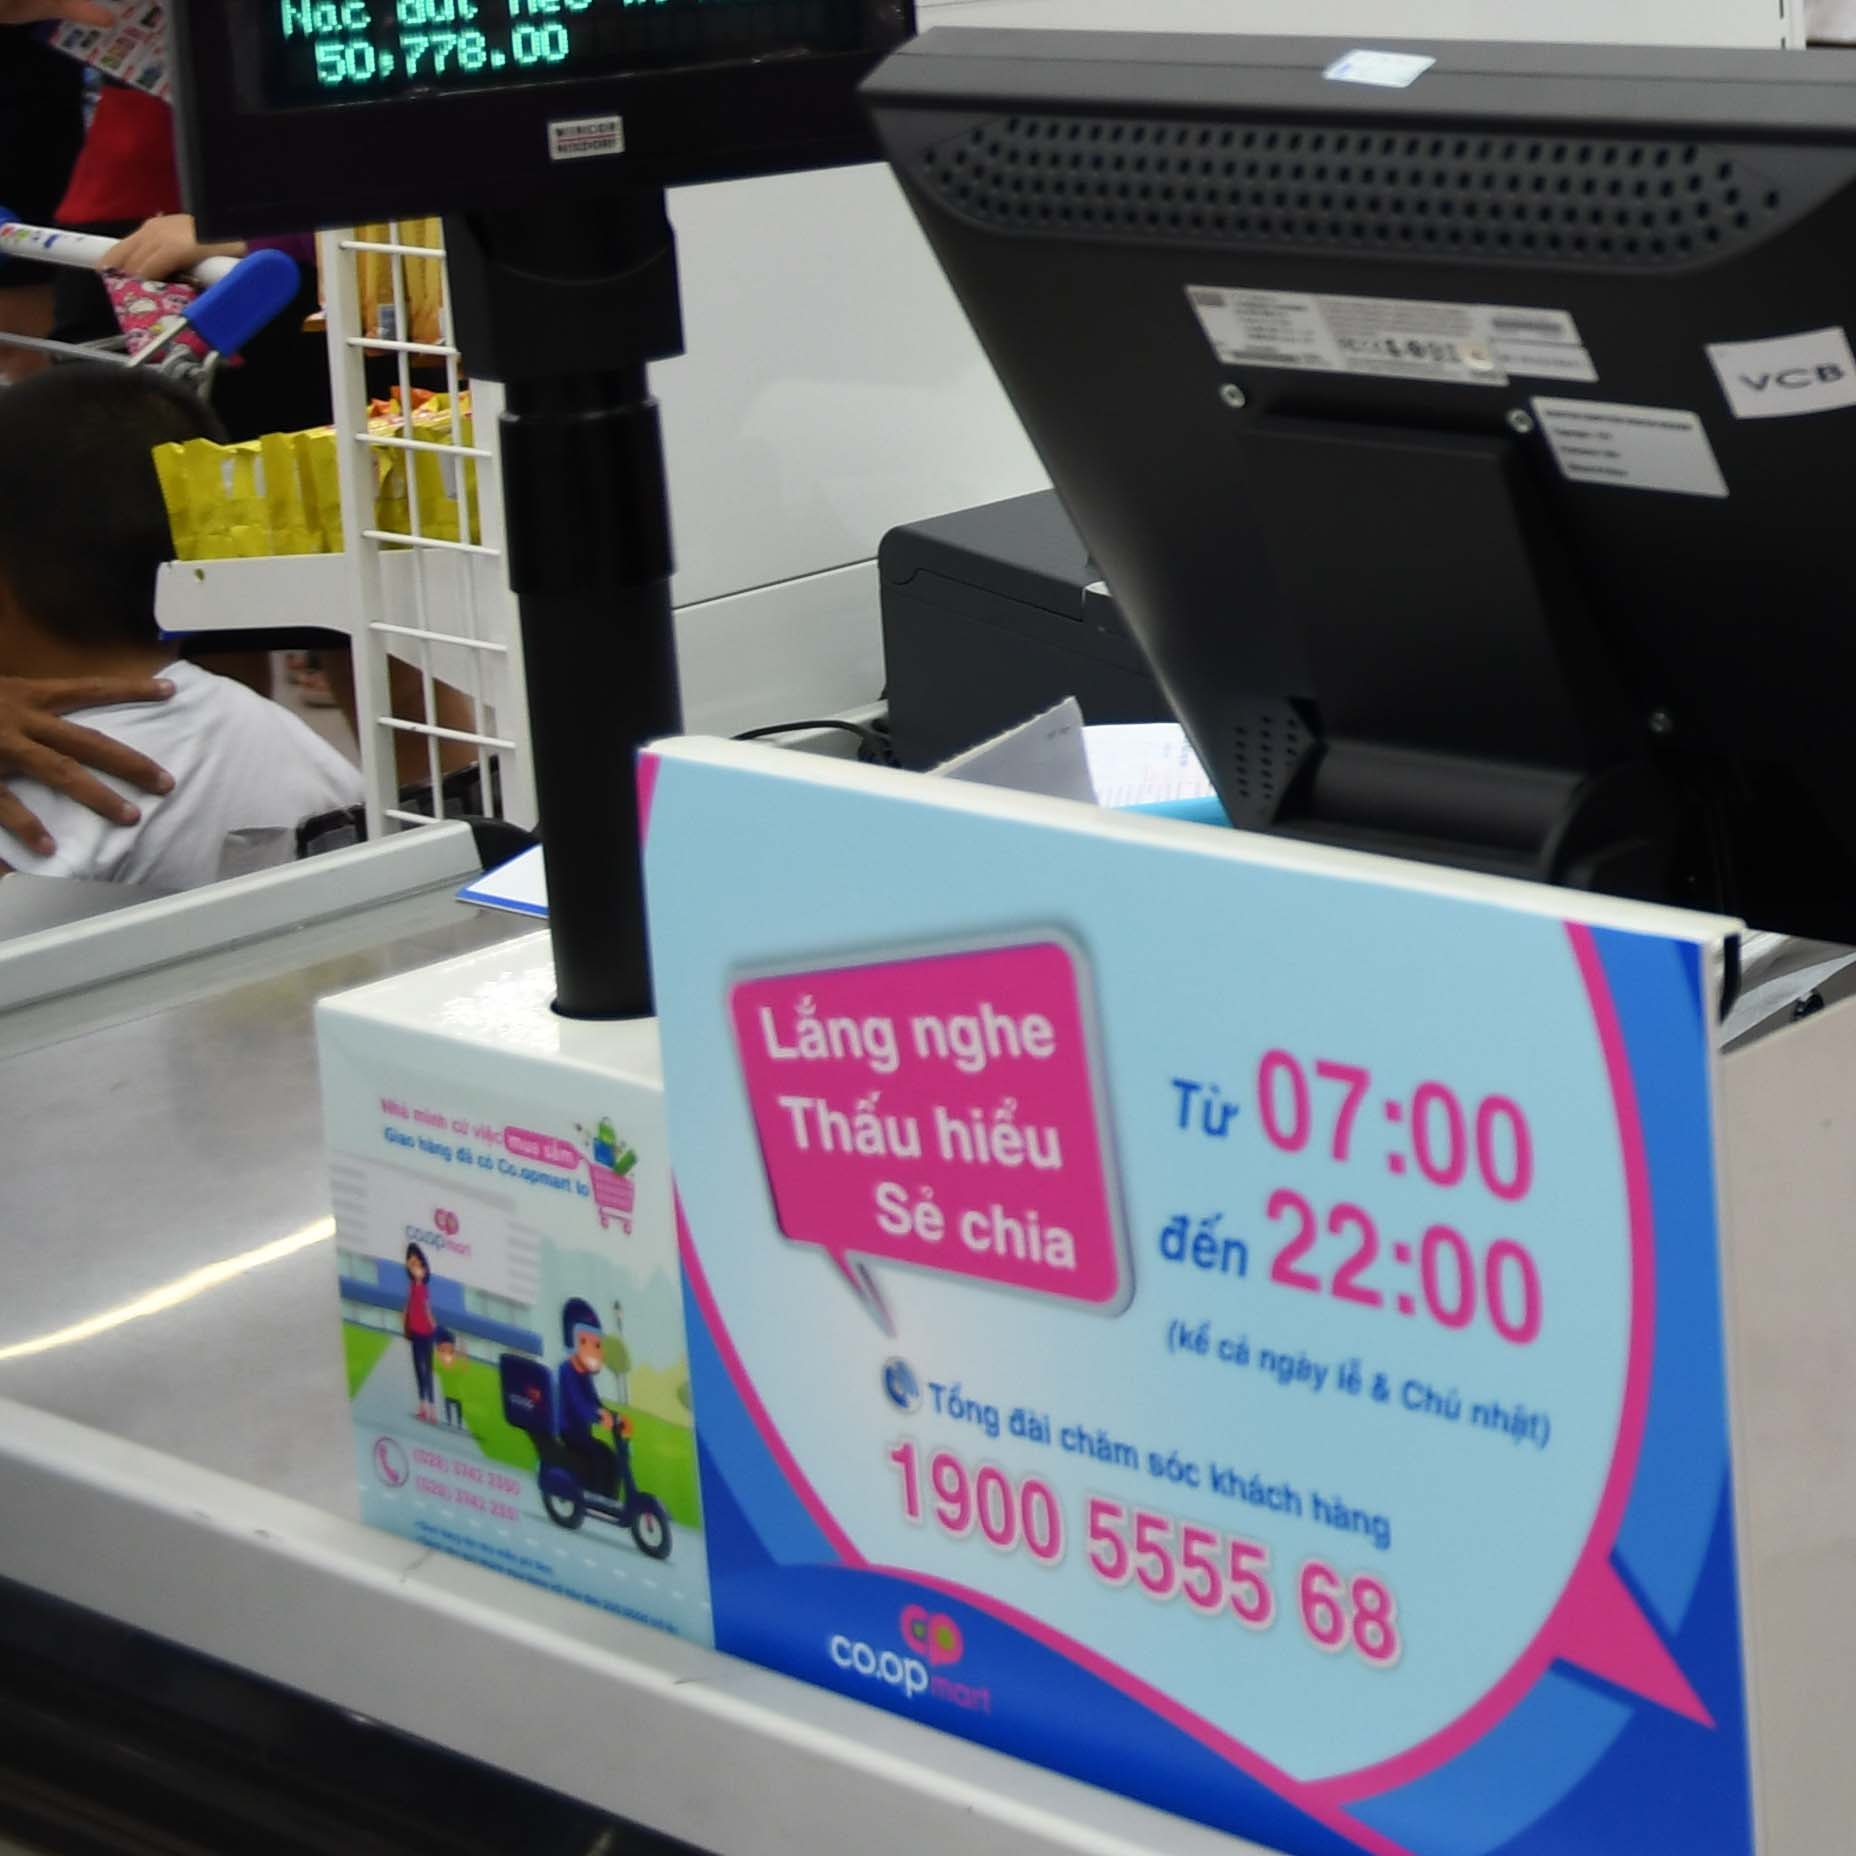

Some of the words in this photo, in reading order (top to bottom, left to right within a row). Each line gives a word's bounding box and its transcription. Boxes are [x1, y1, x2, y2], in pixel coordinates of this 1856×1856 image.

[1738, 359, 1847, 395] VCB
[757, 995, 902, 1073] Lắng
[913, 1002, 1057, 1068] nghe
[779, 1091, 921, 1162] Thấu
[934, 1093, 1064, 1174] hiểu
[1170, 1076, 1241, 1142] Từ
[1255, 1047, 1535, 1205] 07:00
[874, 1179, 945, 1245] Sẻ
[959, 1204, 1077, 1274] chia
[1160, 1213, 1249, 1281] đến
[1265, 1188, 1544, 1347] 22:00
[1257, 1342, 1332, 1400] ngày
[1370, 1367, 1392, 1403] &
[1399, 1375, 1463, 1426] Chủ
[1469, 1391, 1553, 1452] nhật)
[926, 1378, 1001, 1439] Tổng
[1006, 1399, 1053, 1447] đài
[1059, 1410, 1141, 1466] chăm
[1146, 1437, 1201, 1489] sóc
[1209, 1462, 1303, 1519] khách
[1310, 1489, 1393, 1550] hàng
[888, 1438, 1064, 1568] 1900
[1083, 1496, 1275, 1629] 5555
[1296, 1559, 1402, 1667] 68
